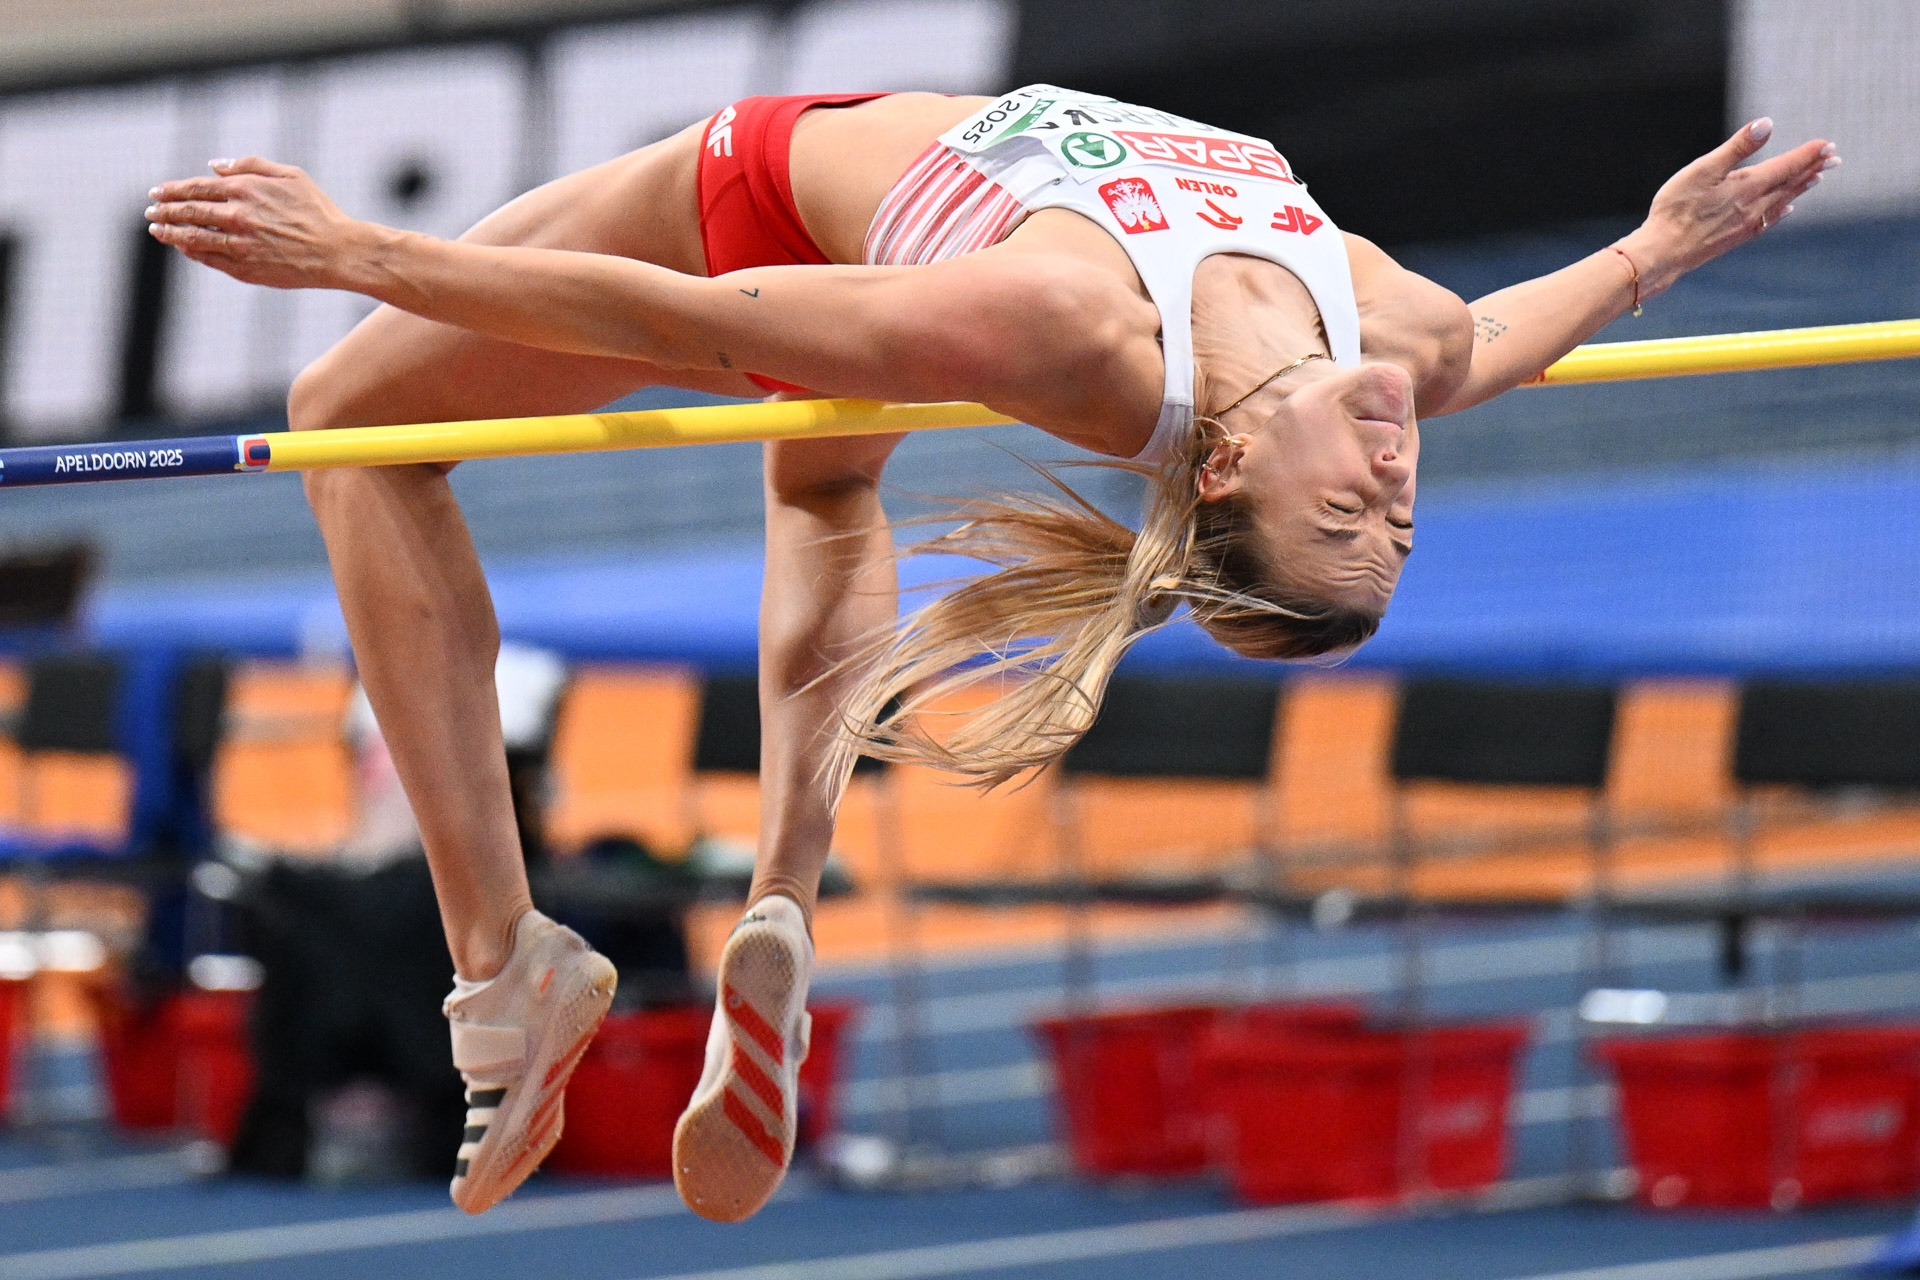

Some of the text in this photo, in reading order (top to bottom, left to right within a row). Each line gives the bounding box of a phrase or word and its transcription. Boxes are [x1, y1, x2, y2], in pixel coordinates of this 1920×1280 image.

[962, 100, 1021, 144] 2025
[1122, 134, 1288, 179] SPAR
[1174, 177, 1239, 198] ORLEN
[1270, 204, 1324, 236] 4F
[55, 448, 184, 473] APELDOORN 2025
